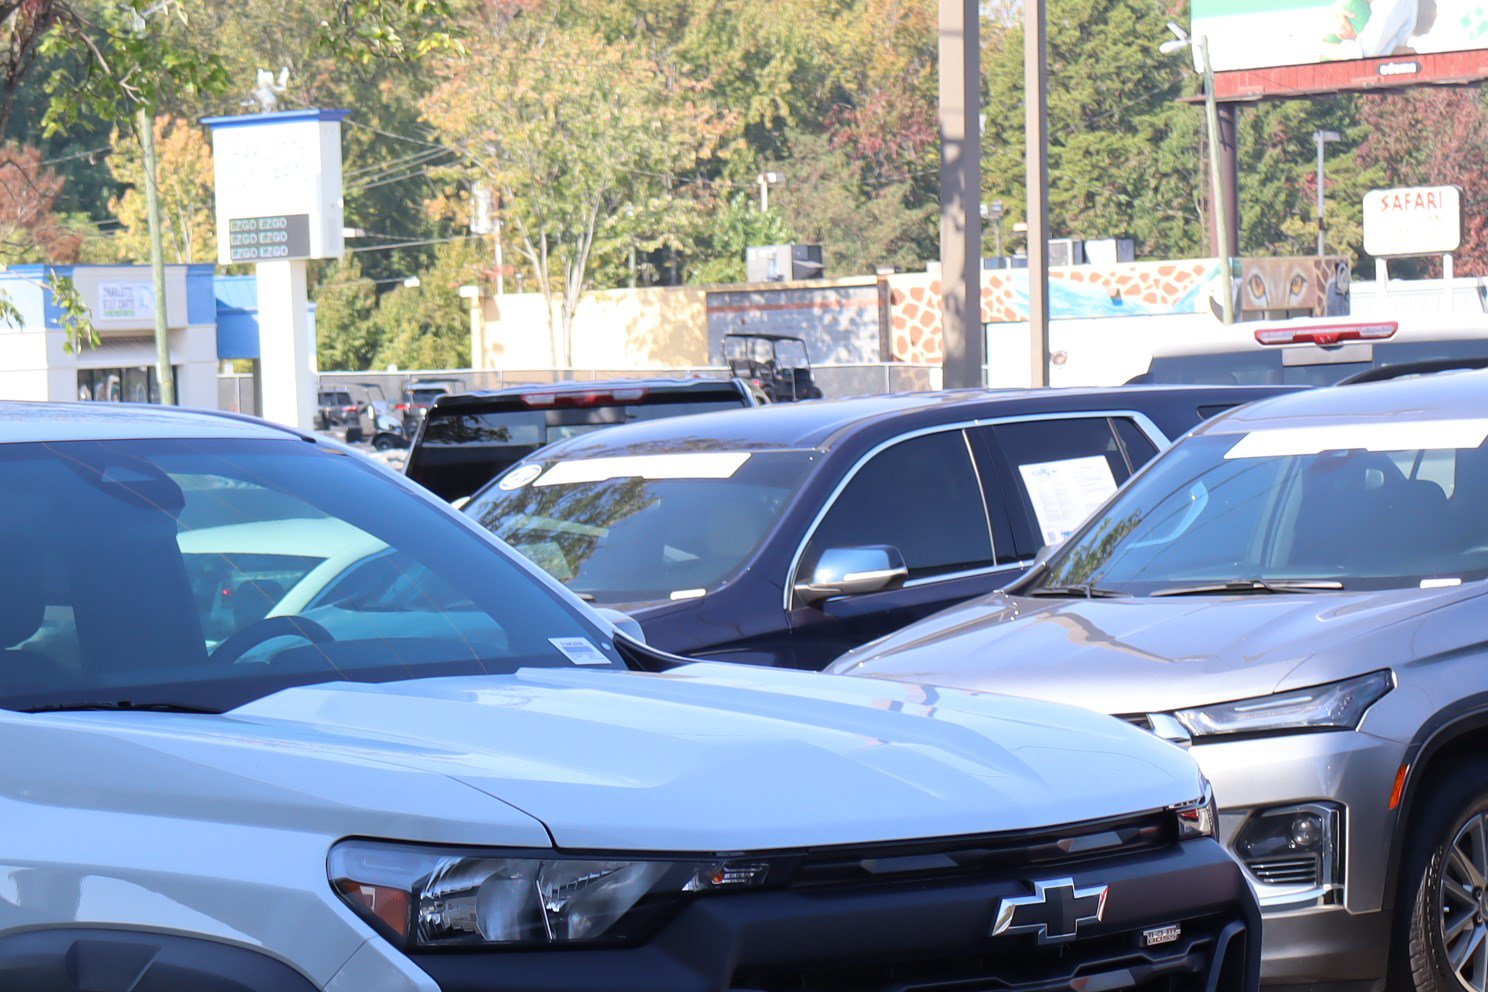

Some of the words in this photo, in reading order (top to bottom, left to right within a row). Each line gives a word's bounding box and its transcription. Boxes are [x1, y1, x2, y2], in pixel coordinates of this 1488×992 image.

[1381, 192, 1442, 212] SAFARI
[230, 220, 257, 231] EZGO
[259, 217, 287, 229] EZGO
[231, 234, 257, 245] EZGO
[259, 231, 288, 243] EZGO
[231, 247, 258, 259] EZGO
[260, 245, 289, 257] EZGO
